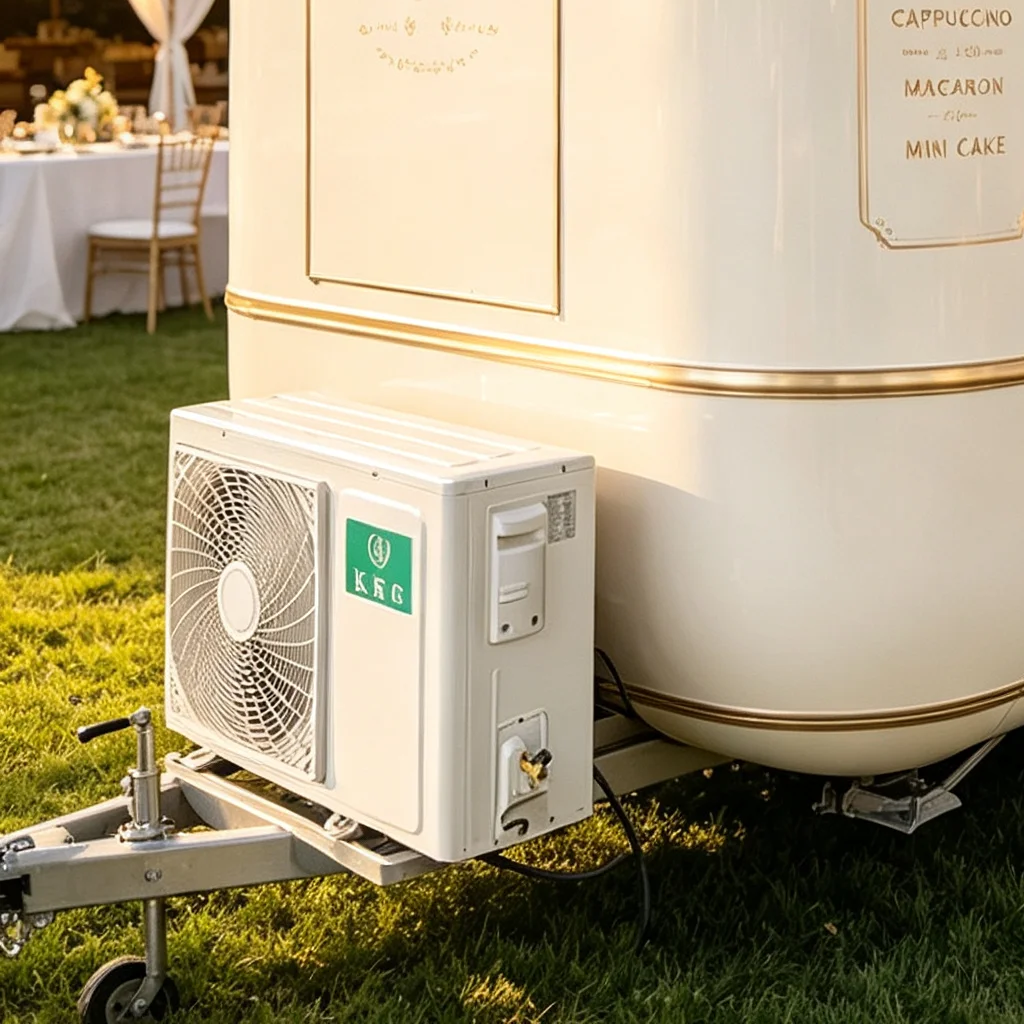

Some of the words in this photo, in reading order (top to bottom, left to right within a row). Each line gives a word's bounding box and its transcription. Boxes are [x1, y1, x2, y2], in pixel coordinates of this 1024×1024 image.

[904, 76, 1003, 97] MACARON
[905, 138, 947, 159] MINI
[956, 135, 1005, 157] CAKE
